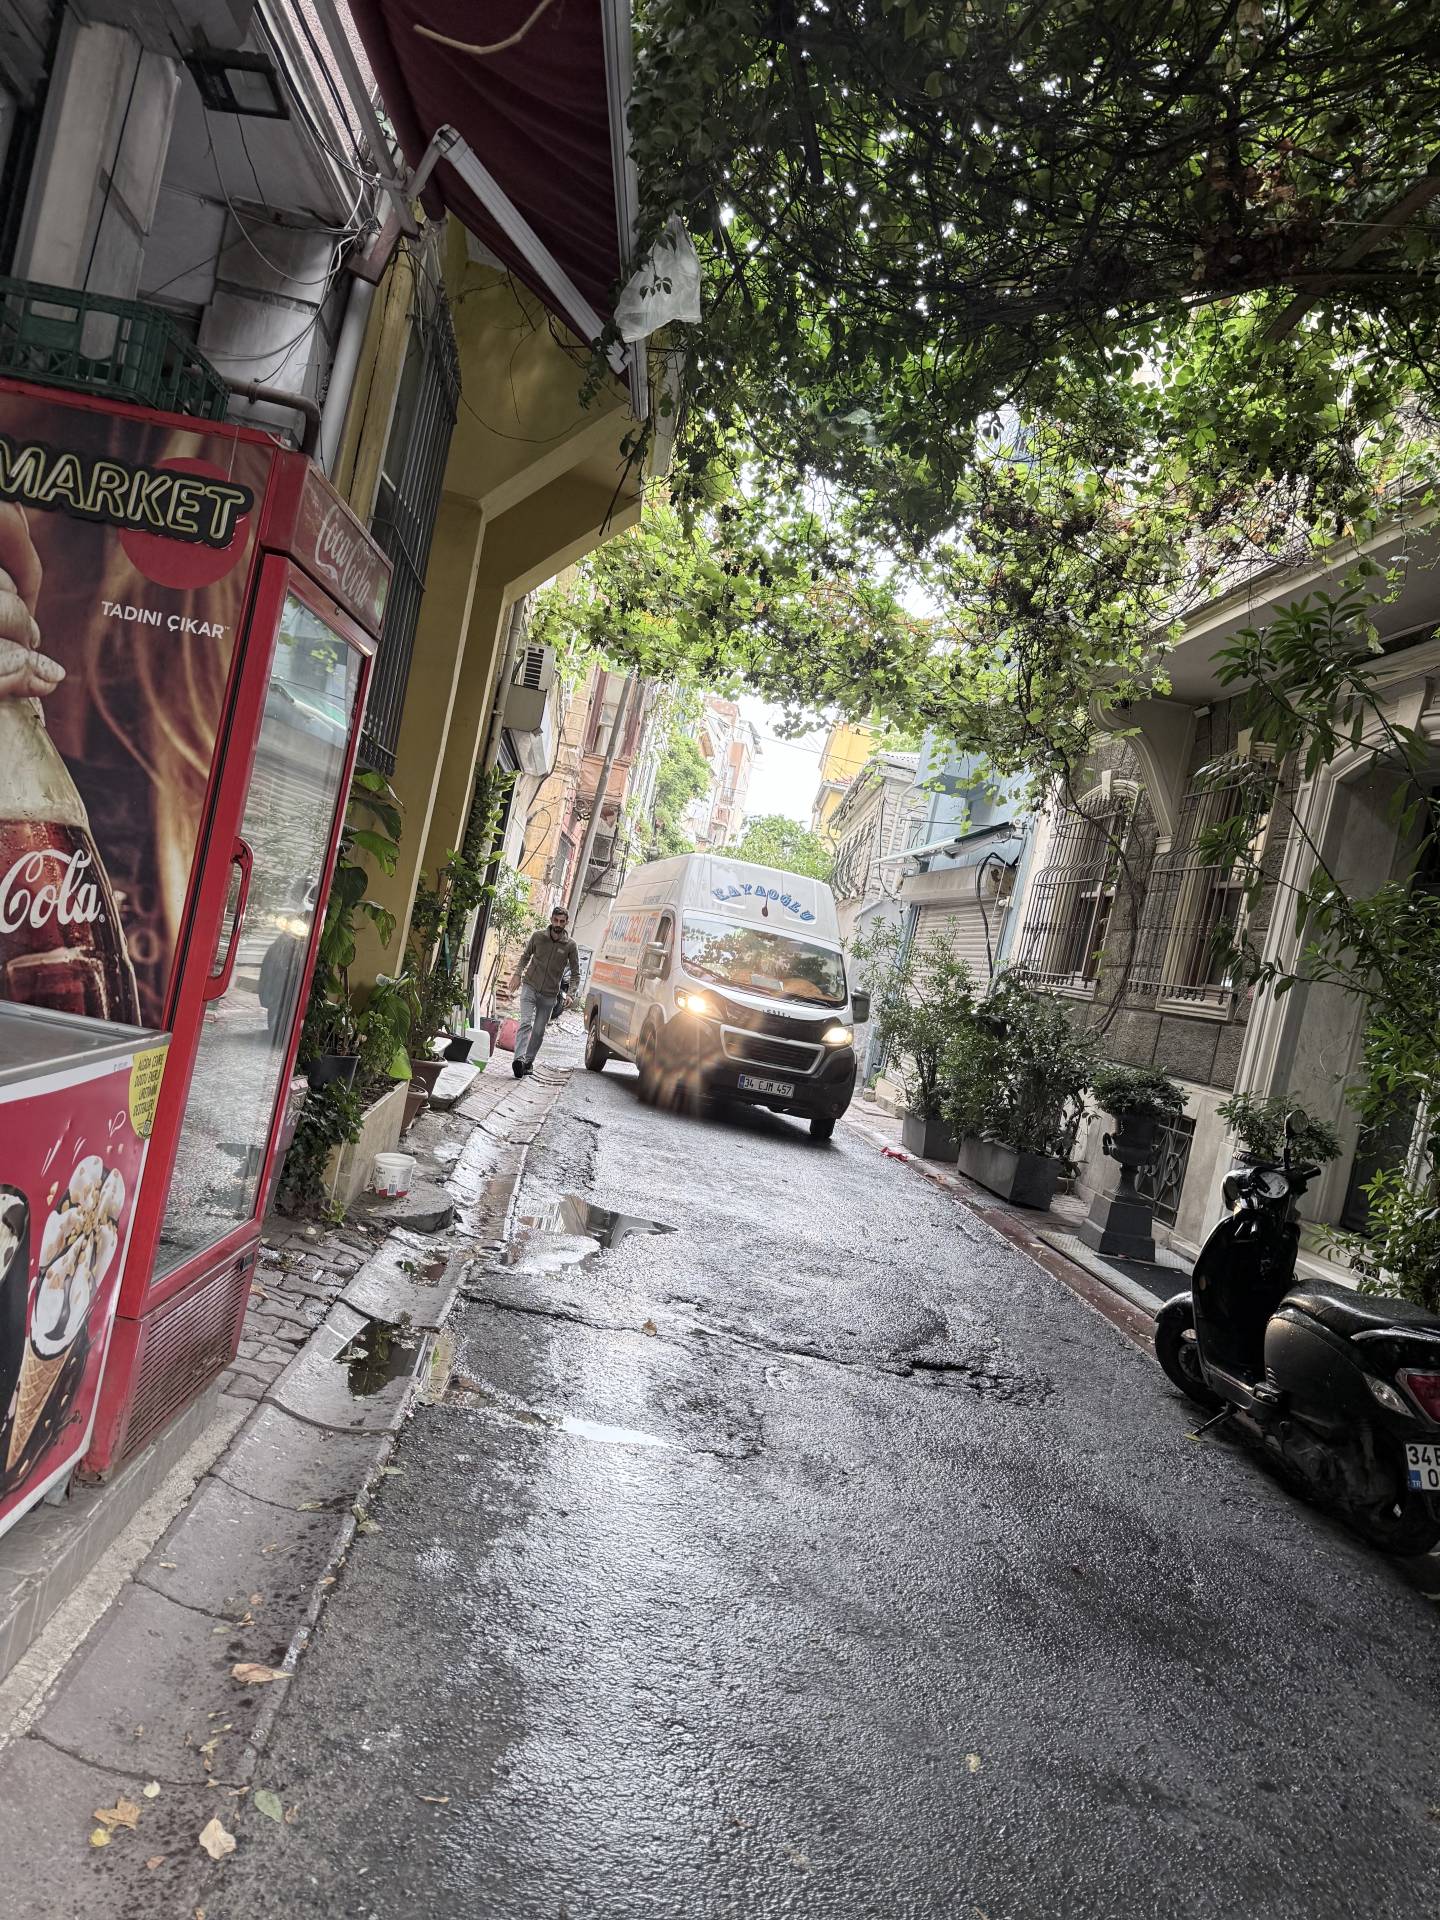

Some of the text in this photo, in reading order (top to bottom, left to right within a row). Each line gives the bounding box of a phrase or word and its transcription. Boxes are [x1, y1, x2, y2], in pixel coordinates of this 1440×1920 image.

[0, 438, 246, 539] MARKET
[101, 600, 163, 627] TADINI
[744, 1078, 754, 1088] 34
[777, 1084, 792, 1096] 457
